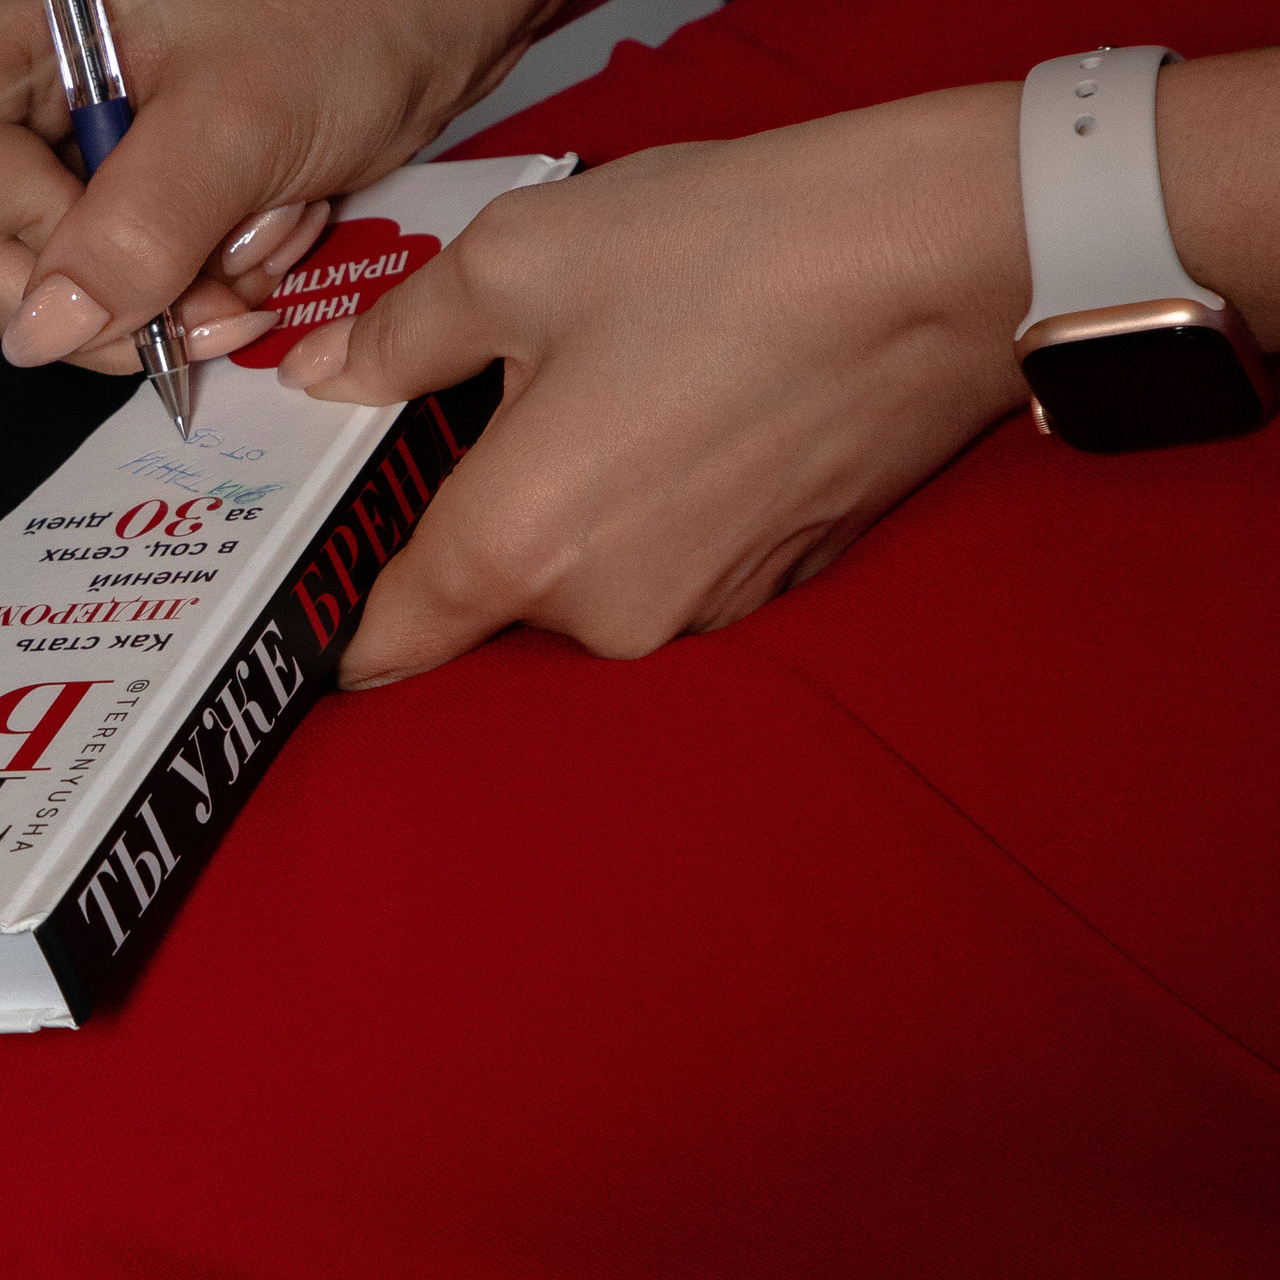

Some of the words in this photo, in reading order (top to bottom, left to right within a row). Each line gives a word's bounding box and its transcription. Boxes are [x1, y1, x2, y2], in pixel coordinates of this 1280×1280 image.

[271, 248, 410, 300] ПРАКТИ
[273, 291, 362, 330] КНИГ
[22, 511, 114, 536] дней
[114, 495, 224, 541] 30
[224, 507, 264, 524] за
[38, 545, 130, 565] сетях
[143, 539, 209, 561] соц.
[216, 540, 239, 556] в
[86, 569, 219, 593] мнений
[15, 636, 101, 654] стать
[106, 632, 174, 653] Как
[8, 677, 151, 856] @TERENYUSHA
[75, 789, 183, 958] ТЫ
[164, 618, 306, 827] УЖЕ
